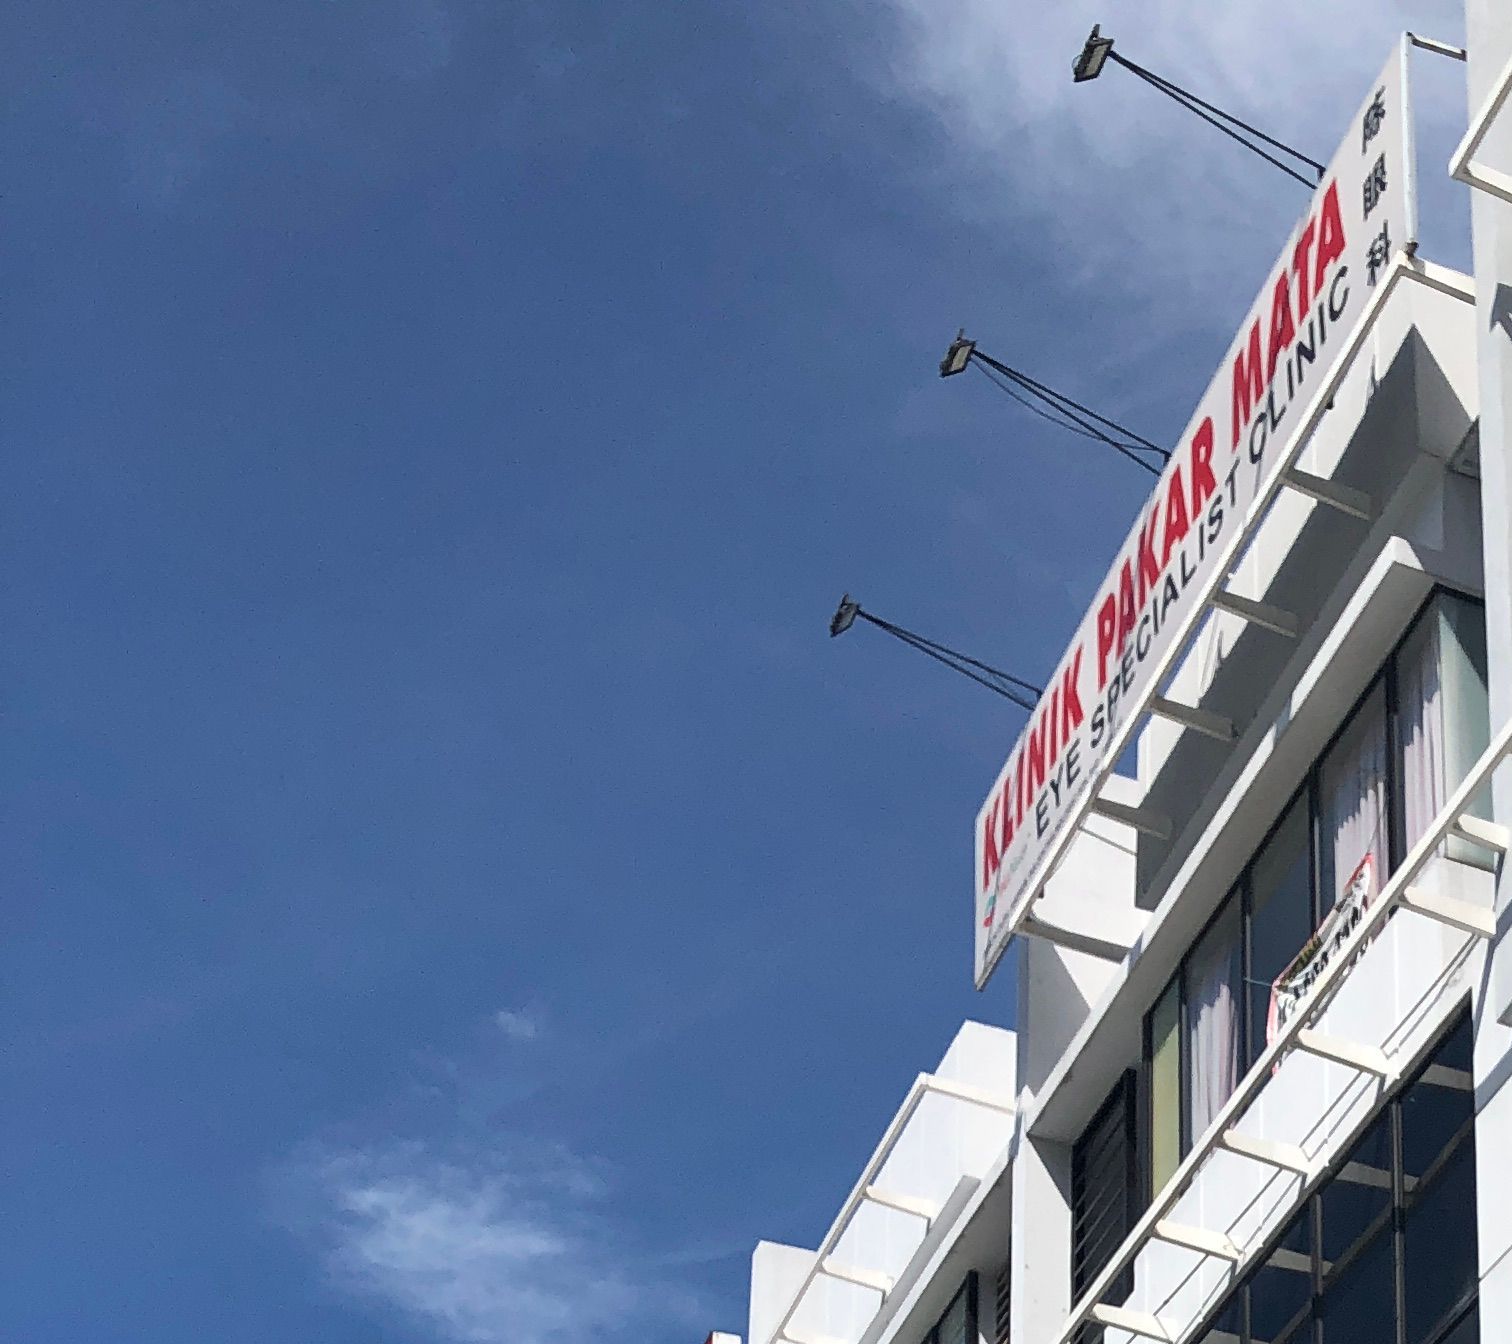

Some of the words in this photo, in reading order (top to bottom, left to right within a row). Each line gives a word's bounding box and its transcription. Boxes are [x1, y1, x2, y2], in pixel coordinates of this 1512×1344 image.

[982, 643, 1084, 892] KLINIK
[1097, 416, 1216, 693] PAKAR
[1232, 177, 1346, 452] MATA
[1034, 738, 1081, 841] EYE
[1090, 456, 1241, 749] SPECIALIST
[1248, 264, 1351, 466] CLINIC
